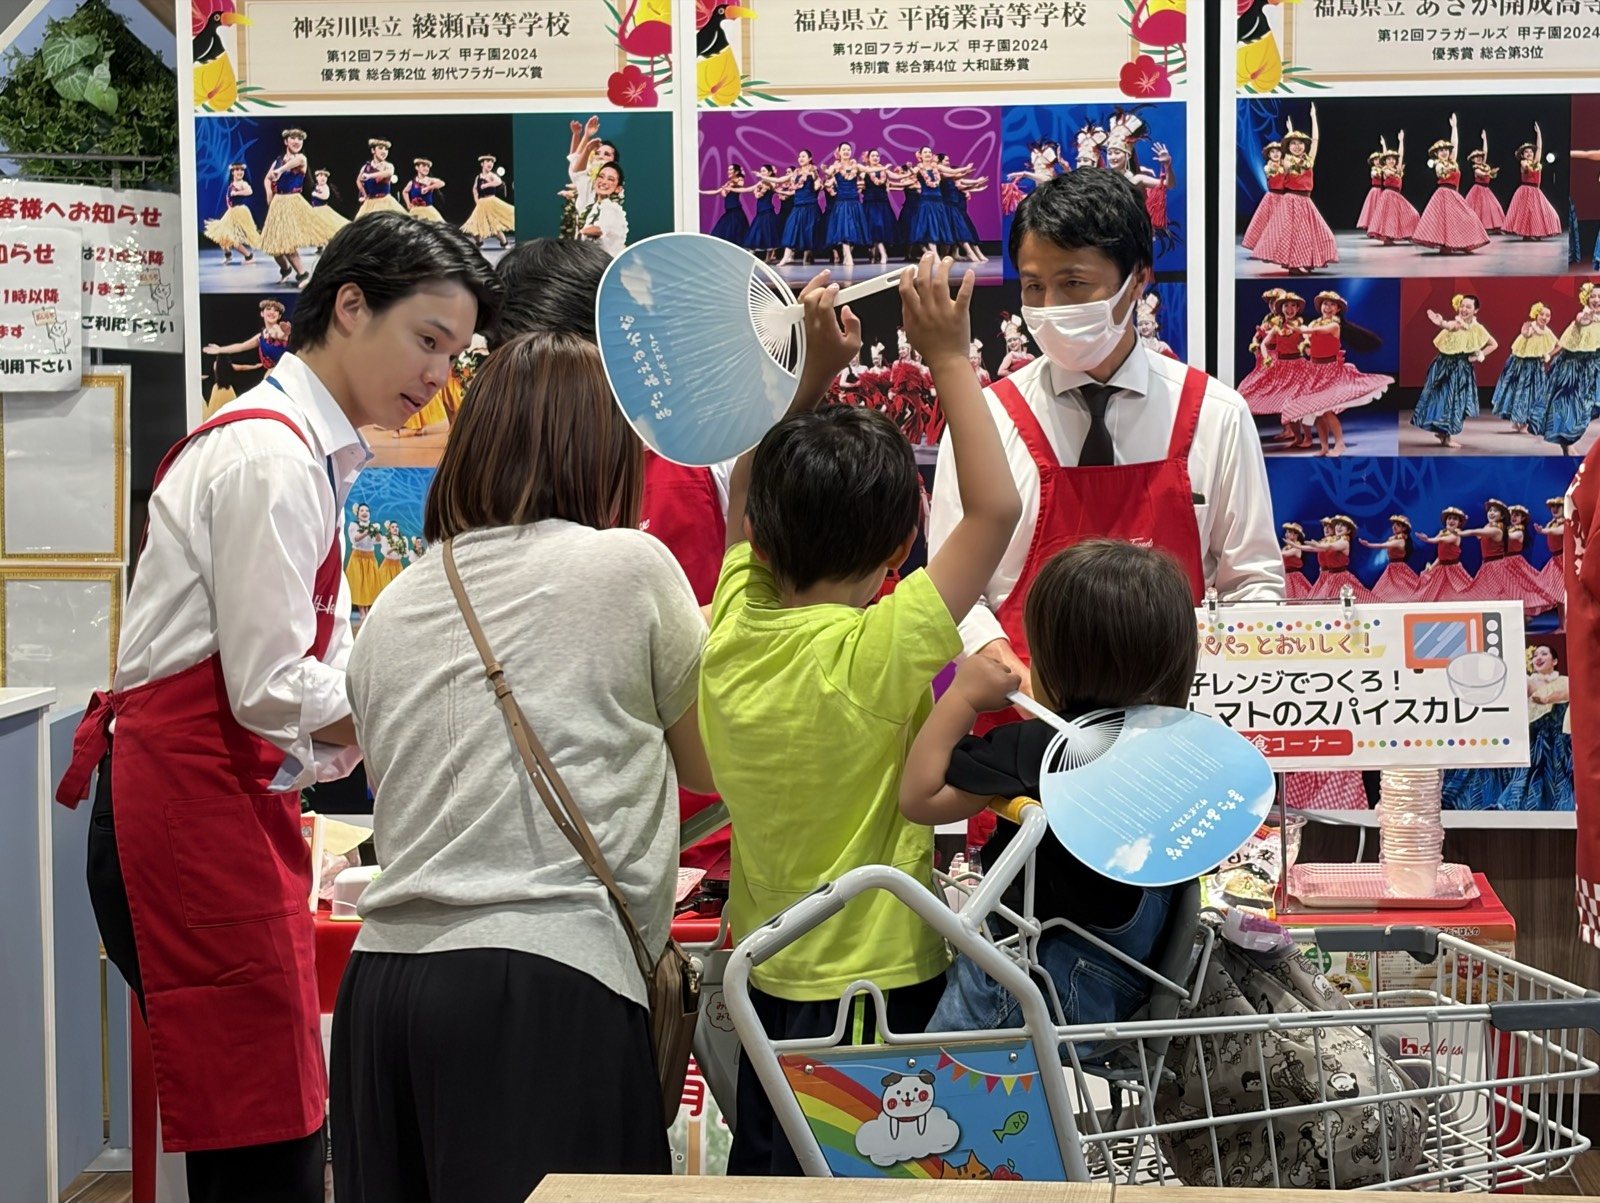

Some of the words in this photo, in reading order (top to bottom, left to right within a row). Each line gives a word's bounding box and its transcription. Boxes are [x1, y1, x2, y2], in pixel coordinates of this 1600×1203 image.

[794, 8, 888, 33] 福島県立
[897, 1, 1087, 32] 平商業高等学校
[1314, 0, 1405, 18] 福島県立
[292, 16, 402, 39] 神奈川県立
[412, 11, 571, 39] 綾瀬高等学校
[1377, 26, 1509, 42] 第12回フラガールズ
[1517, 26, 1600, 40] 甲子園2024
[327, 48, 450, 63] 第12回フラガールズ
[459, 47, 538, 61] 甲子園2024
[832, 39, 959, 56] 第12回フラガールズ
[968, 39, 1048, 53] 甲子園2024
[1432, 47, 1474, 60] 優秀賞
[1480, 45, 1544, 59] 総合第3位
[321, 68, 360, 82] 優秀賞
[366, 67, 426, 81] 総合第2位
[432, 66, 543, 81] 初代フラガールズ賞
[850, 61, 890, 74] 特別賞
[895, 59, 957, 73] 総合第4位
[962, 58, 1030, 72] 大和証券賞
[1245, 733, 1343, 755] 食コーナー
